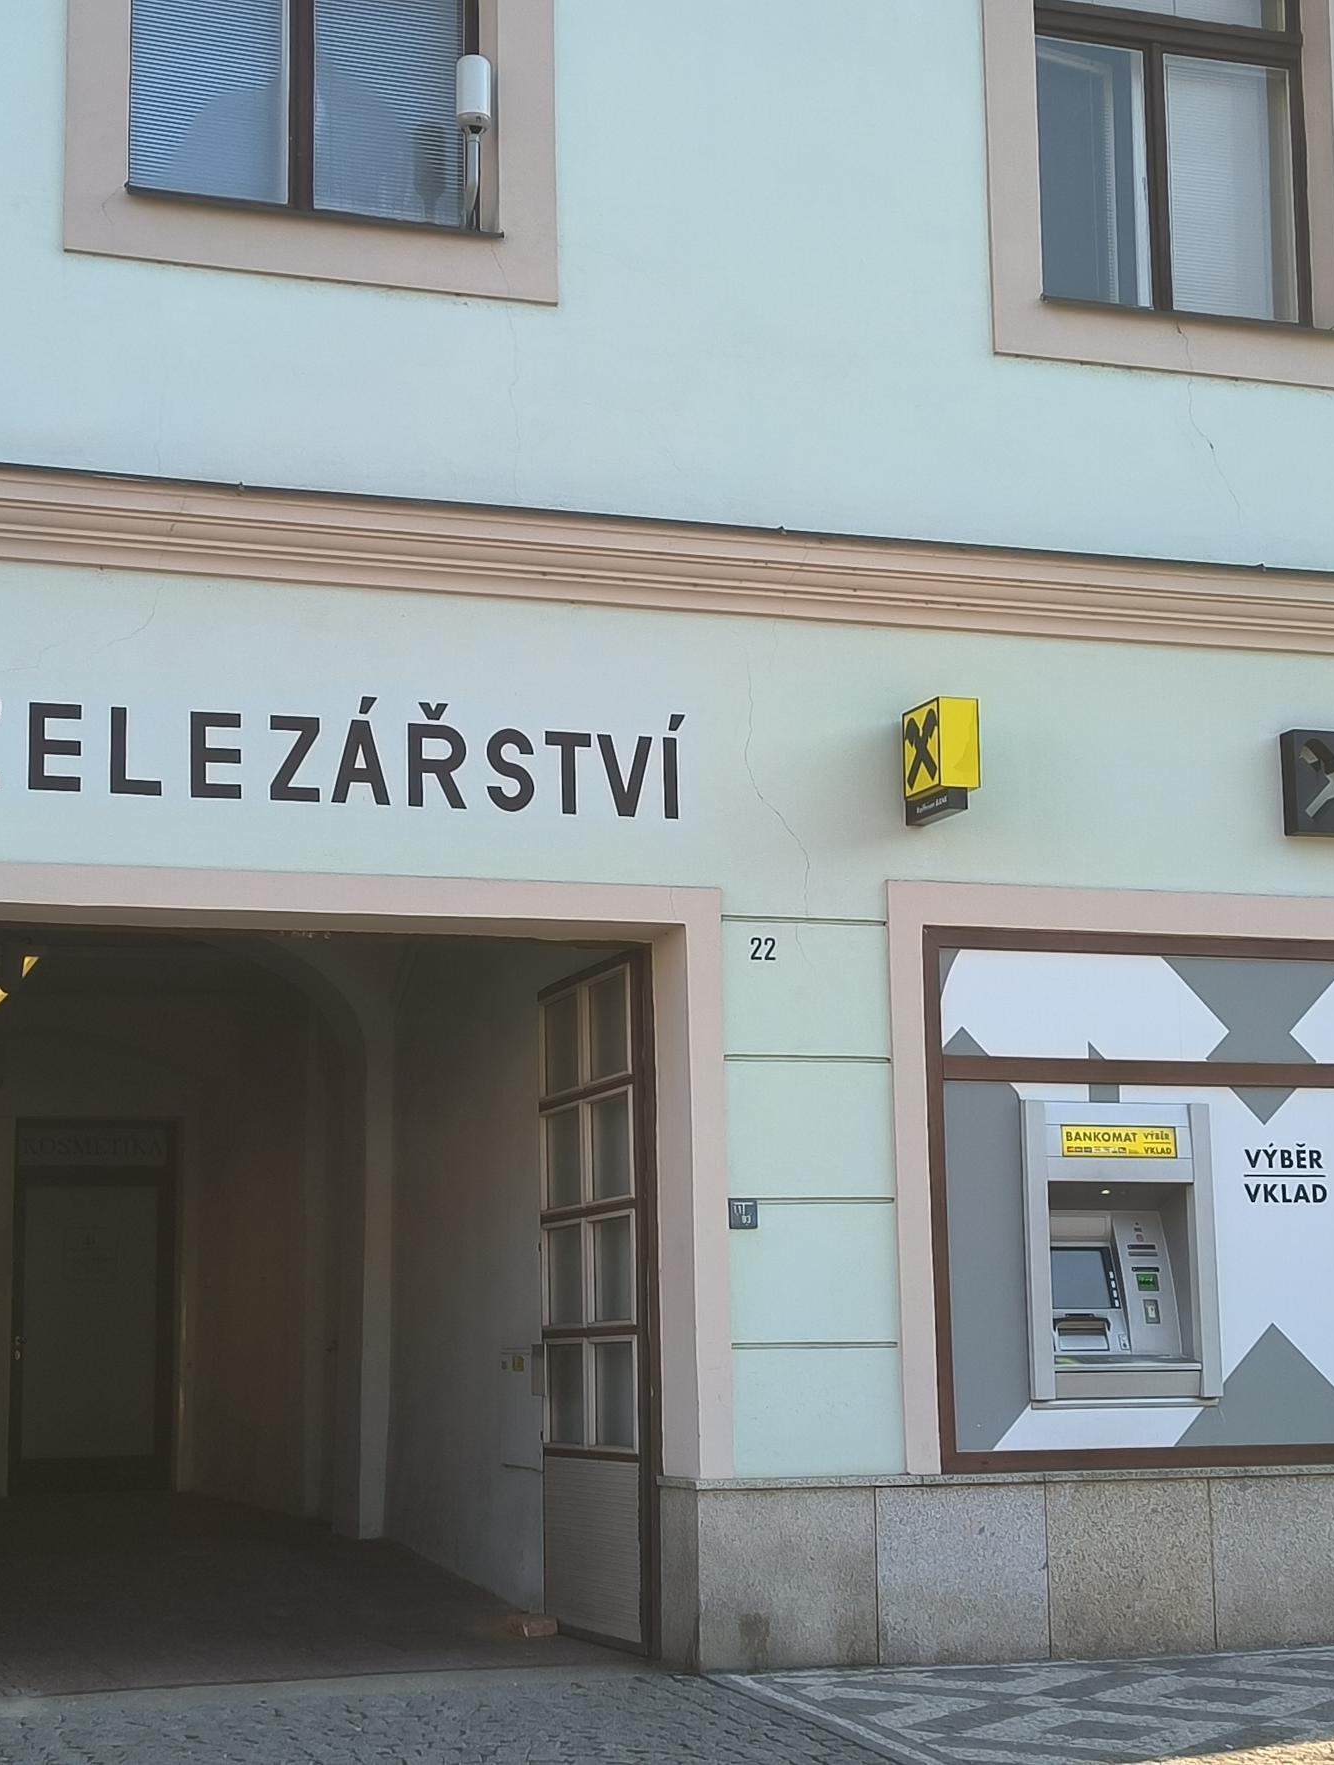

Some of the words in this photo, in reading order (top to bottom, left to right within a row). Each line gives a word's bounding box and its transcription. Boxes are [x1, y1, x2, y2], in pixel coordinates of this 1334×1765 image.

[750, 937, 776, 960] 22
[1065, 1131, 1138, 1143] BANKOMAT
[1143, 1146, 1172, 1155] VKLAD
[1244, 1142, 1324, 1169] VÝBĚR
[1244, 1183, 1328, 1203] VKLAD
